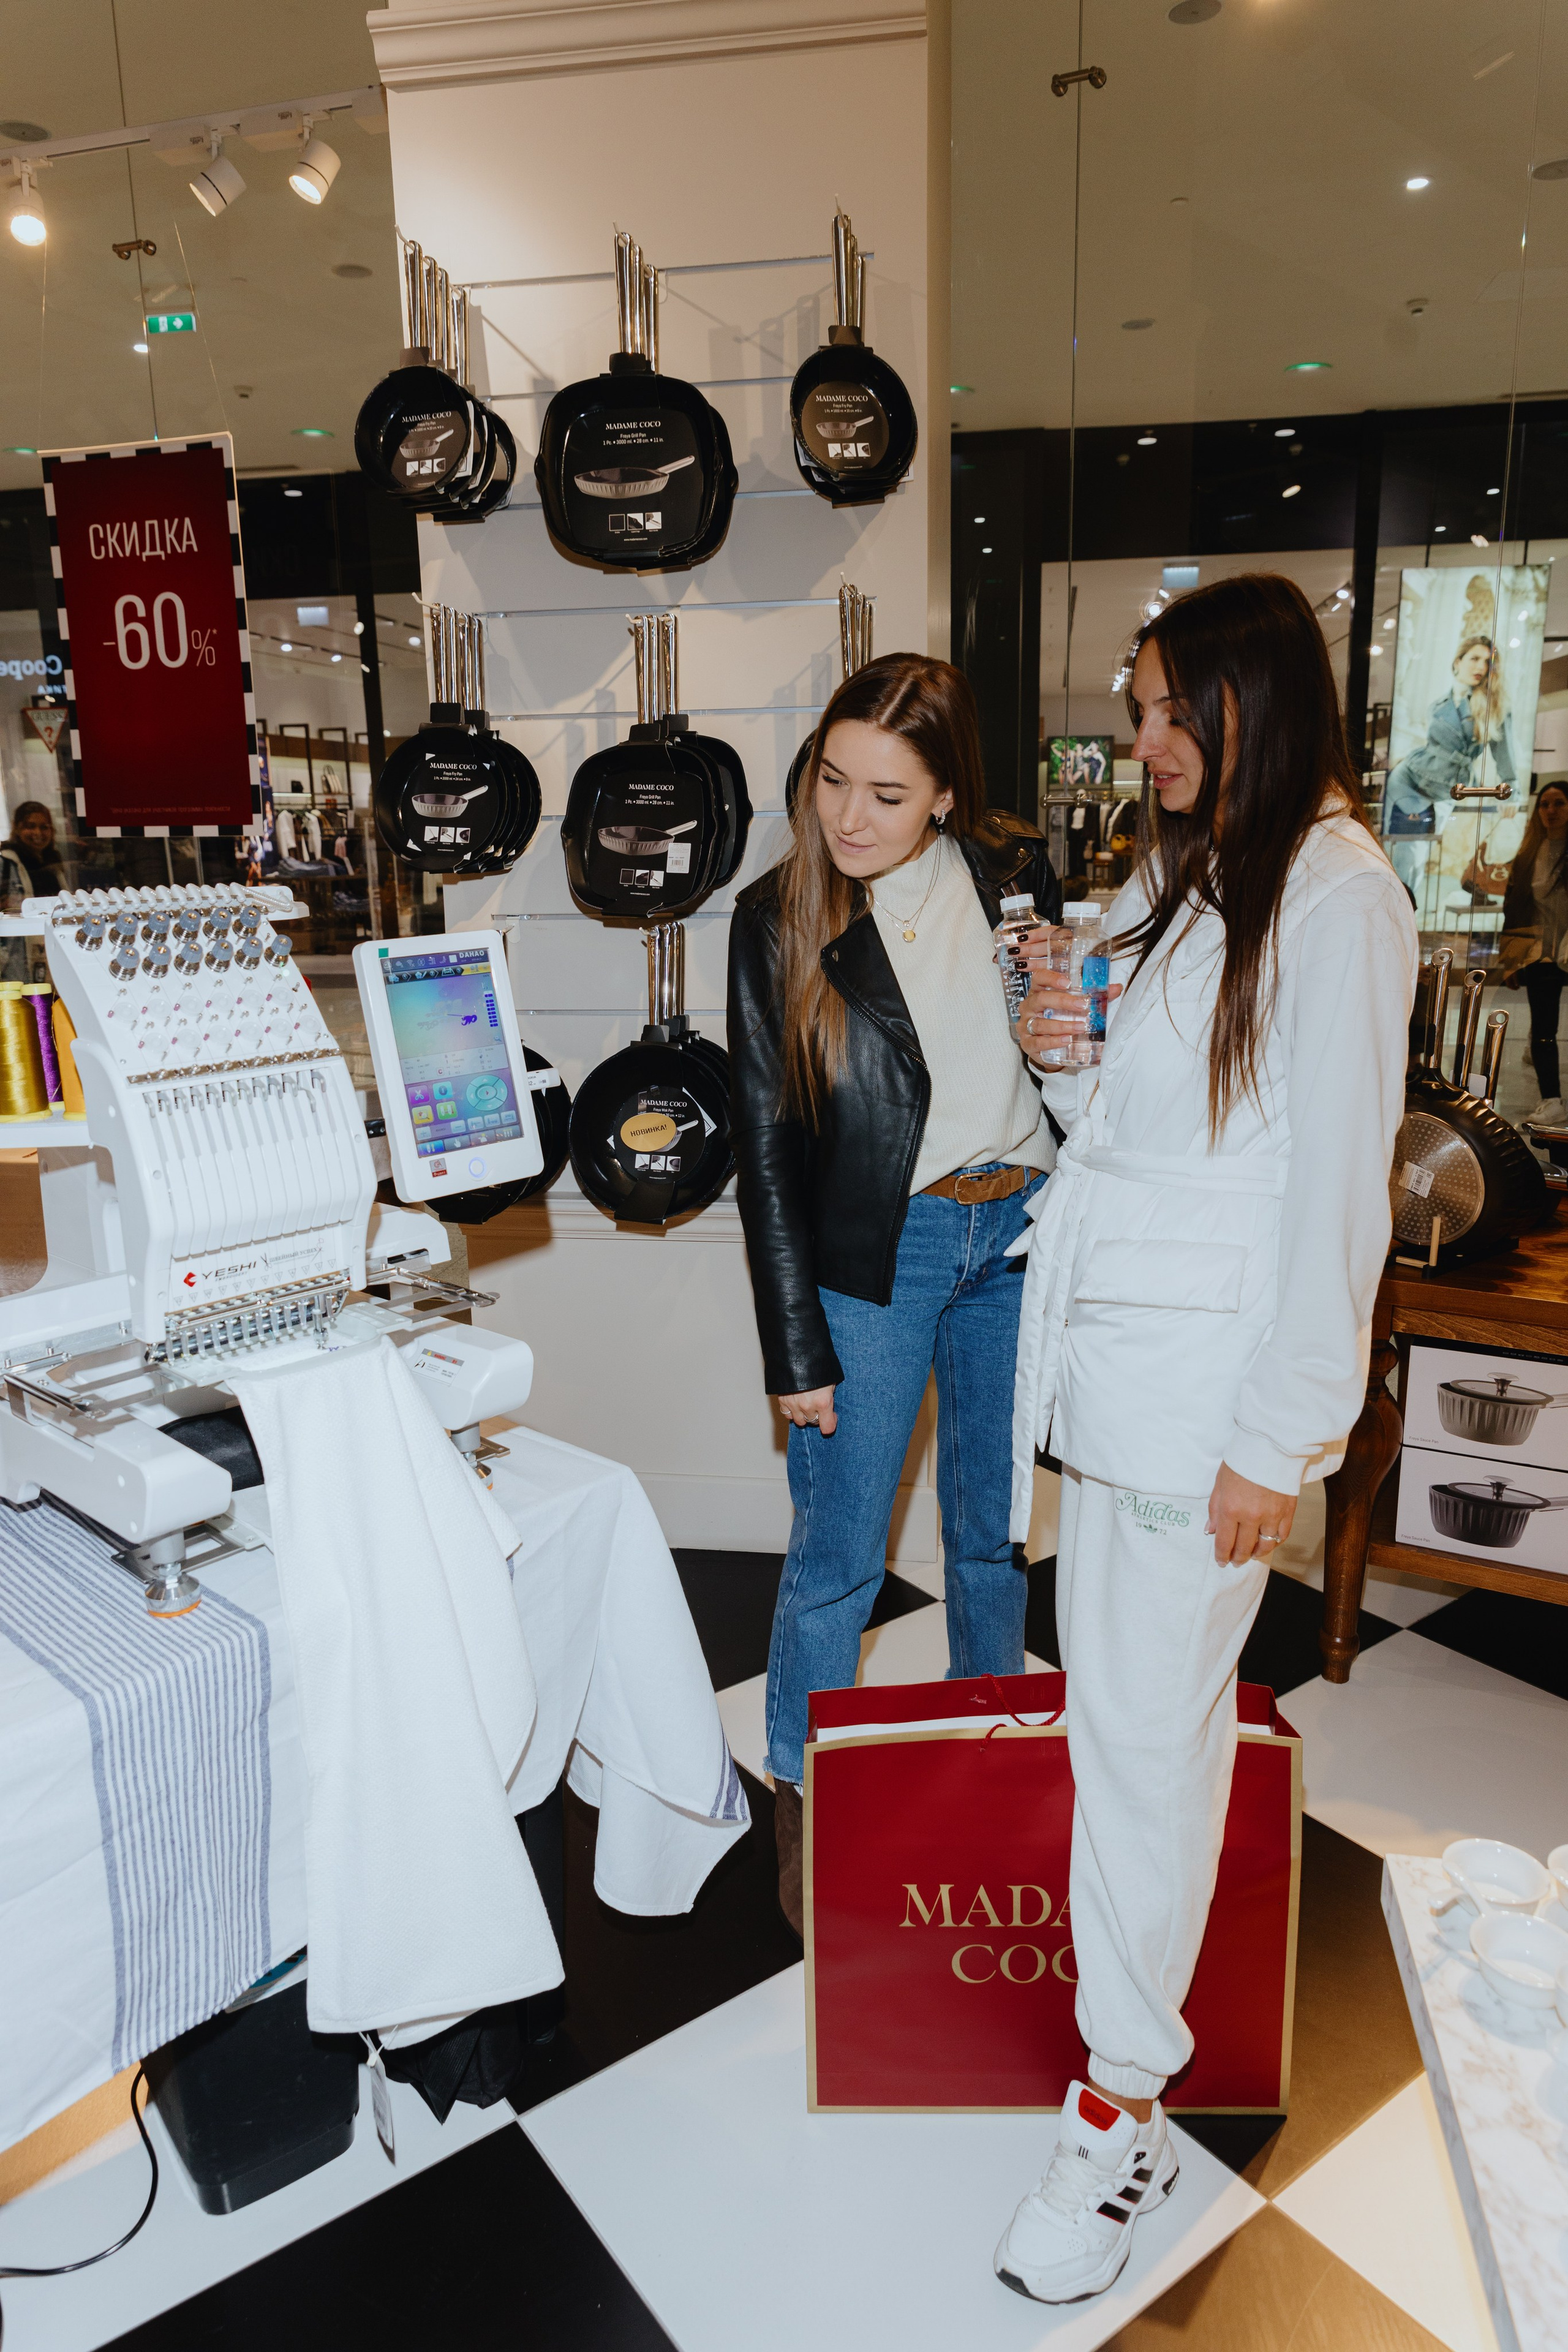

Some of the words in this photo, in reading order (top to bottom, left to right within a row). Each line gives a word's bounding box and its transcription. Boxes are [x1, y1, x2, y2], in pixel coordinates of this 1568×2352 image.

[402, 413, 431, 423] MADAME
[432, 411, 451, 420] COCO
[89, 517, 198, 562] СКИДКА
[630, 1125, 667, 1137] НОВИНКА!
[202, 1261, 257, 1280] YESHI
[1115, 1492, 1191, 1527] Adidas
[1131, 1512, 1158, 1524] ATHLETICS
